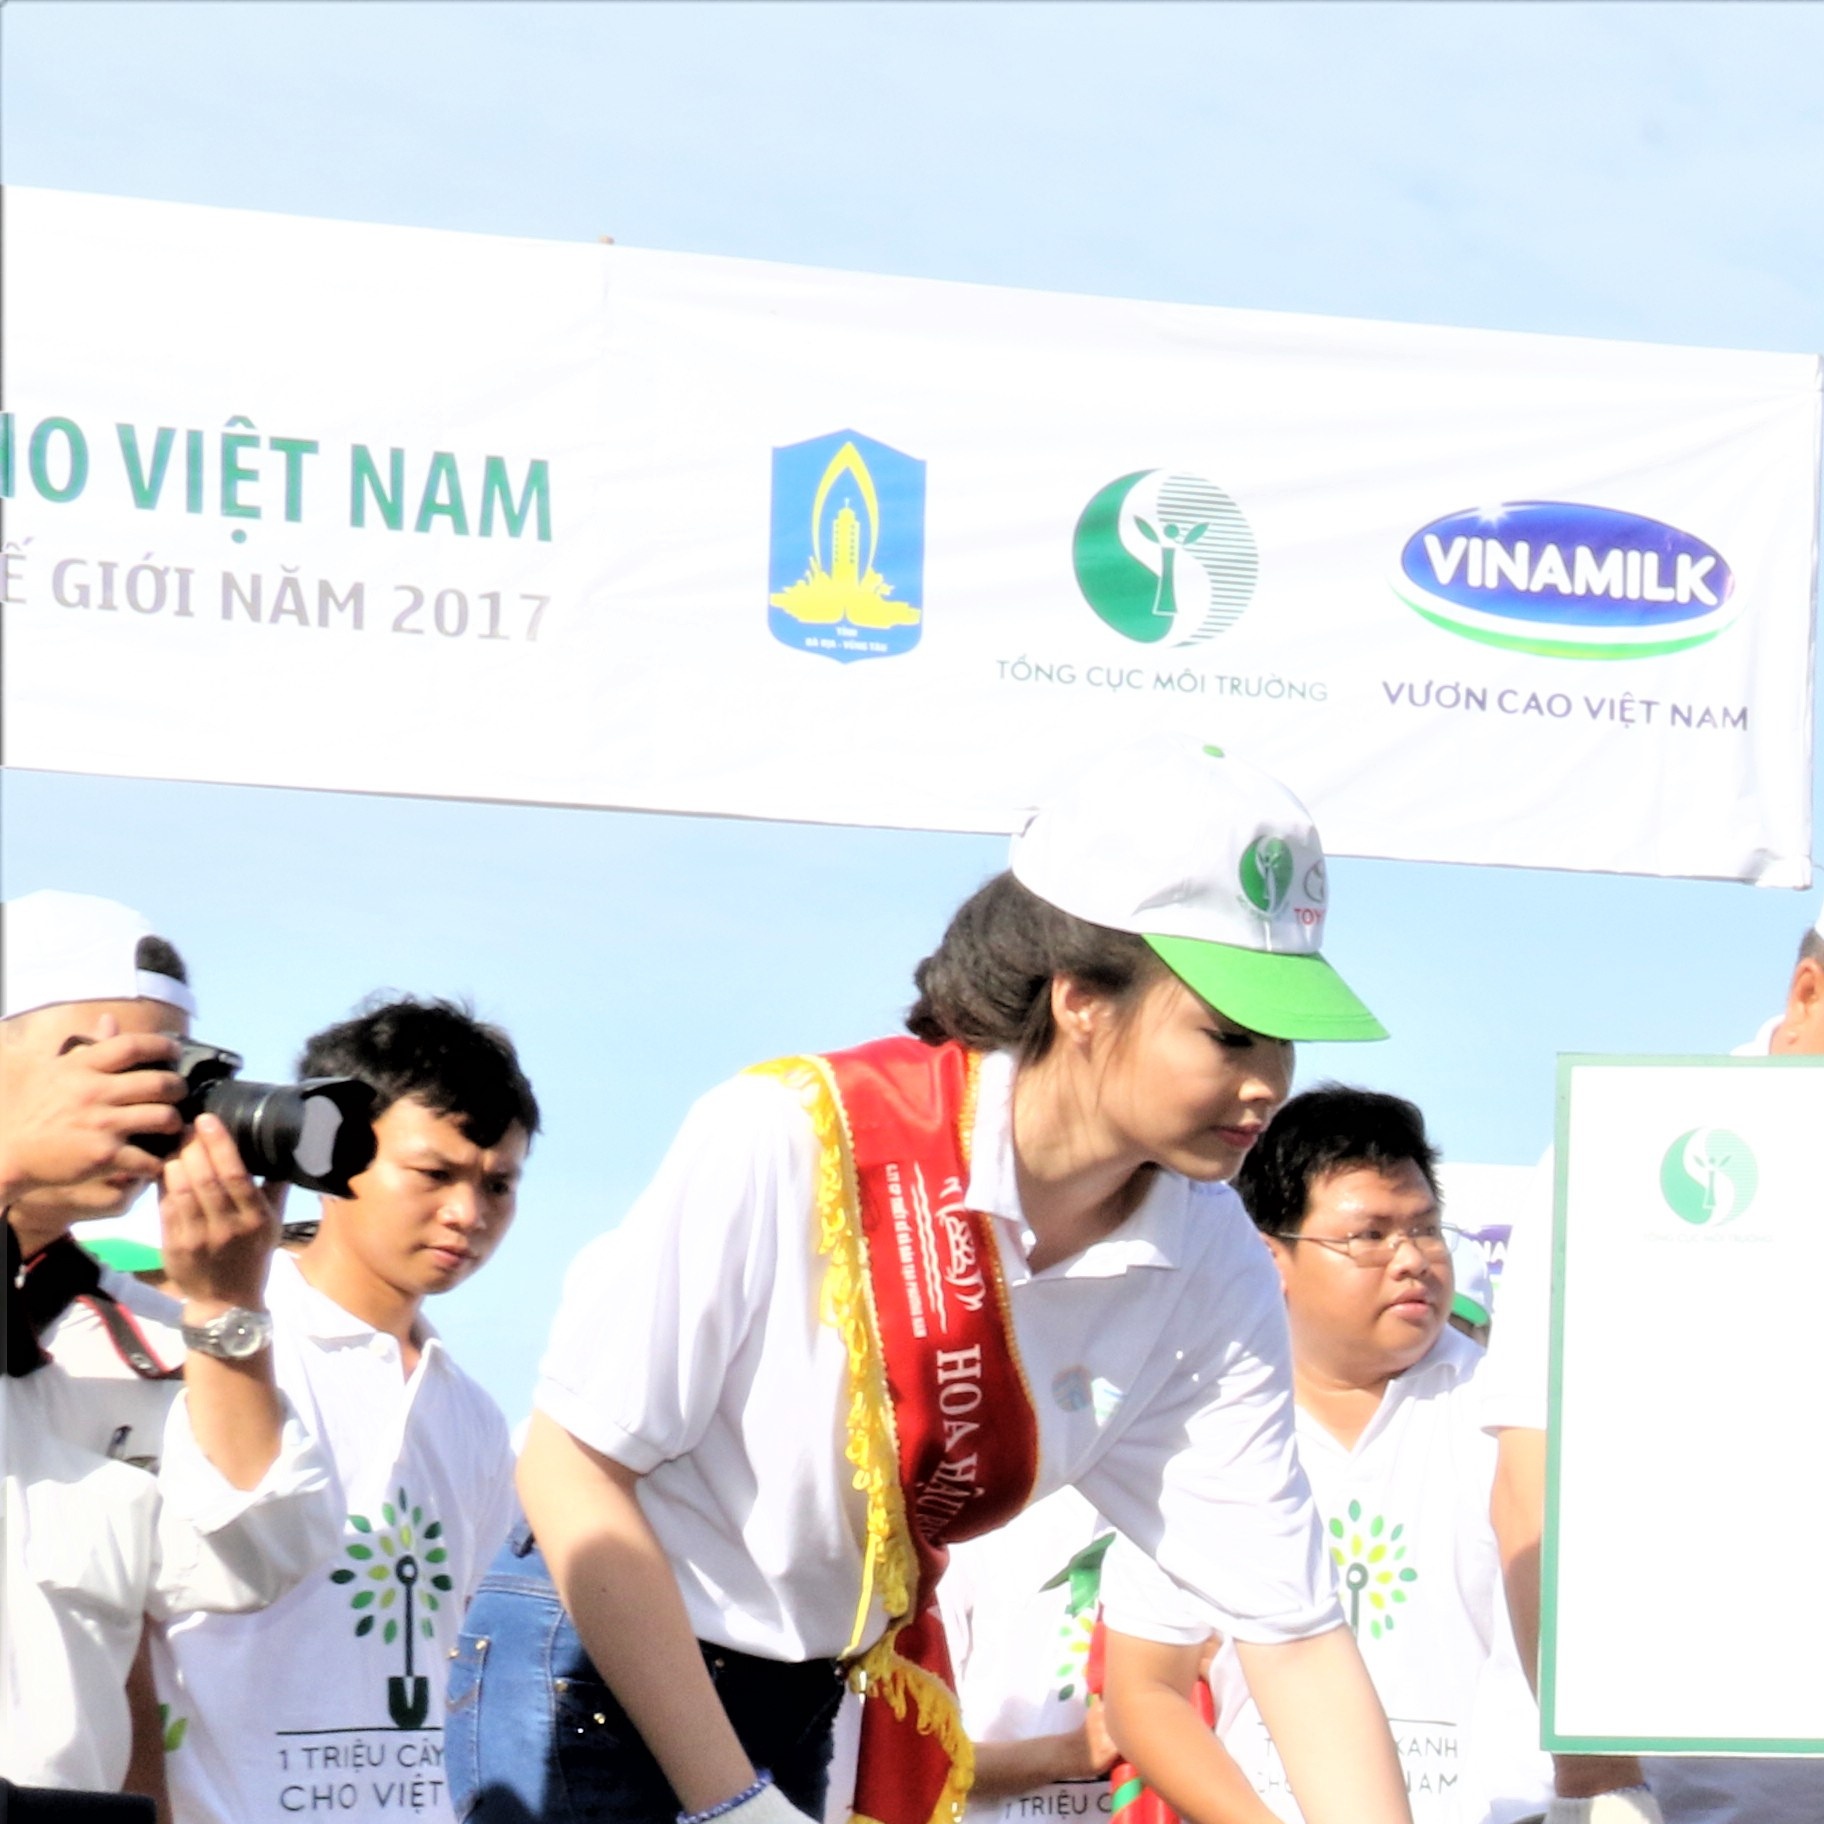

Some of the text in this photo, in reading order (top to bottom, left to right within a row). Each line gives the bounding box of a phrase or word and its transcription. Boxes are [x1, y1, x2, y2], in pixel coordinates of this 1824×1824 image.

[115, 415, 319, 544] VIỆT
[349, 443, 552, 542] NAM
[52, 552, 195, 617] GIỚI
[221, 564, 364, 631] NĂM
[391, 584, 551, 642] 2017
[1422, 533, 1718, 606] VINAMILK
[1086, 666, 1143, 692] CỤC
[1153, 667, 1205, 693] MÔI
[1382, 680, 1748, 731] VƯƠN CAO VIỆT NAM
[936, 1343, 983, 1453] HOA
[916, 1452, 985, 1516] HẬU
[278, 1738, 444, 1773] 1 TRIỆU CÂY
[280, 1773, 444, 1813] CHO VIỆT
[1020, 1789, 1087, 1820] TRIỆU
